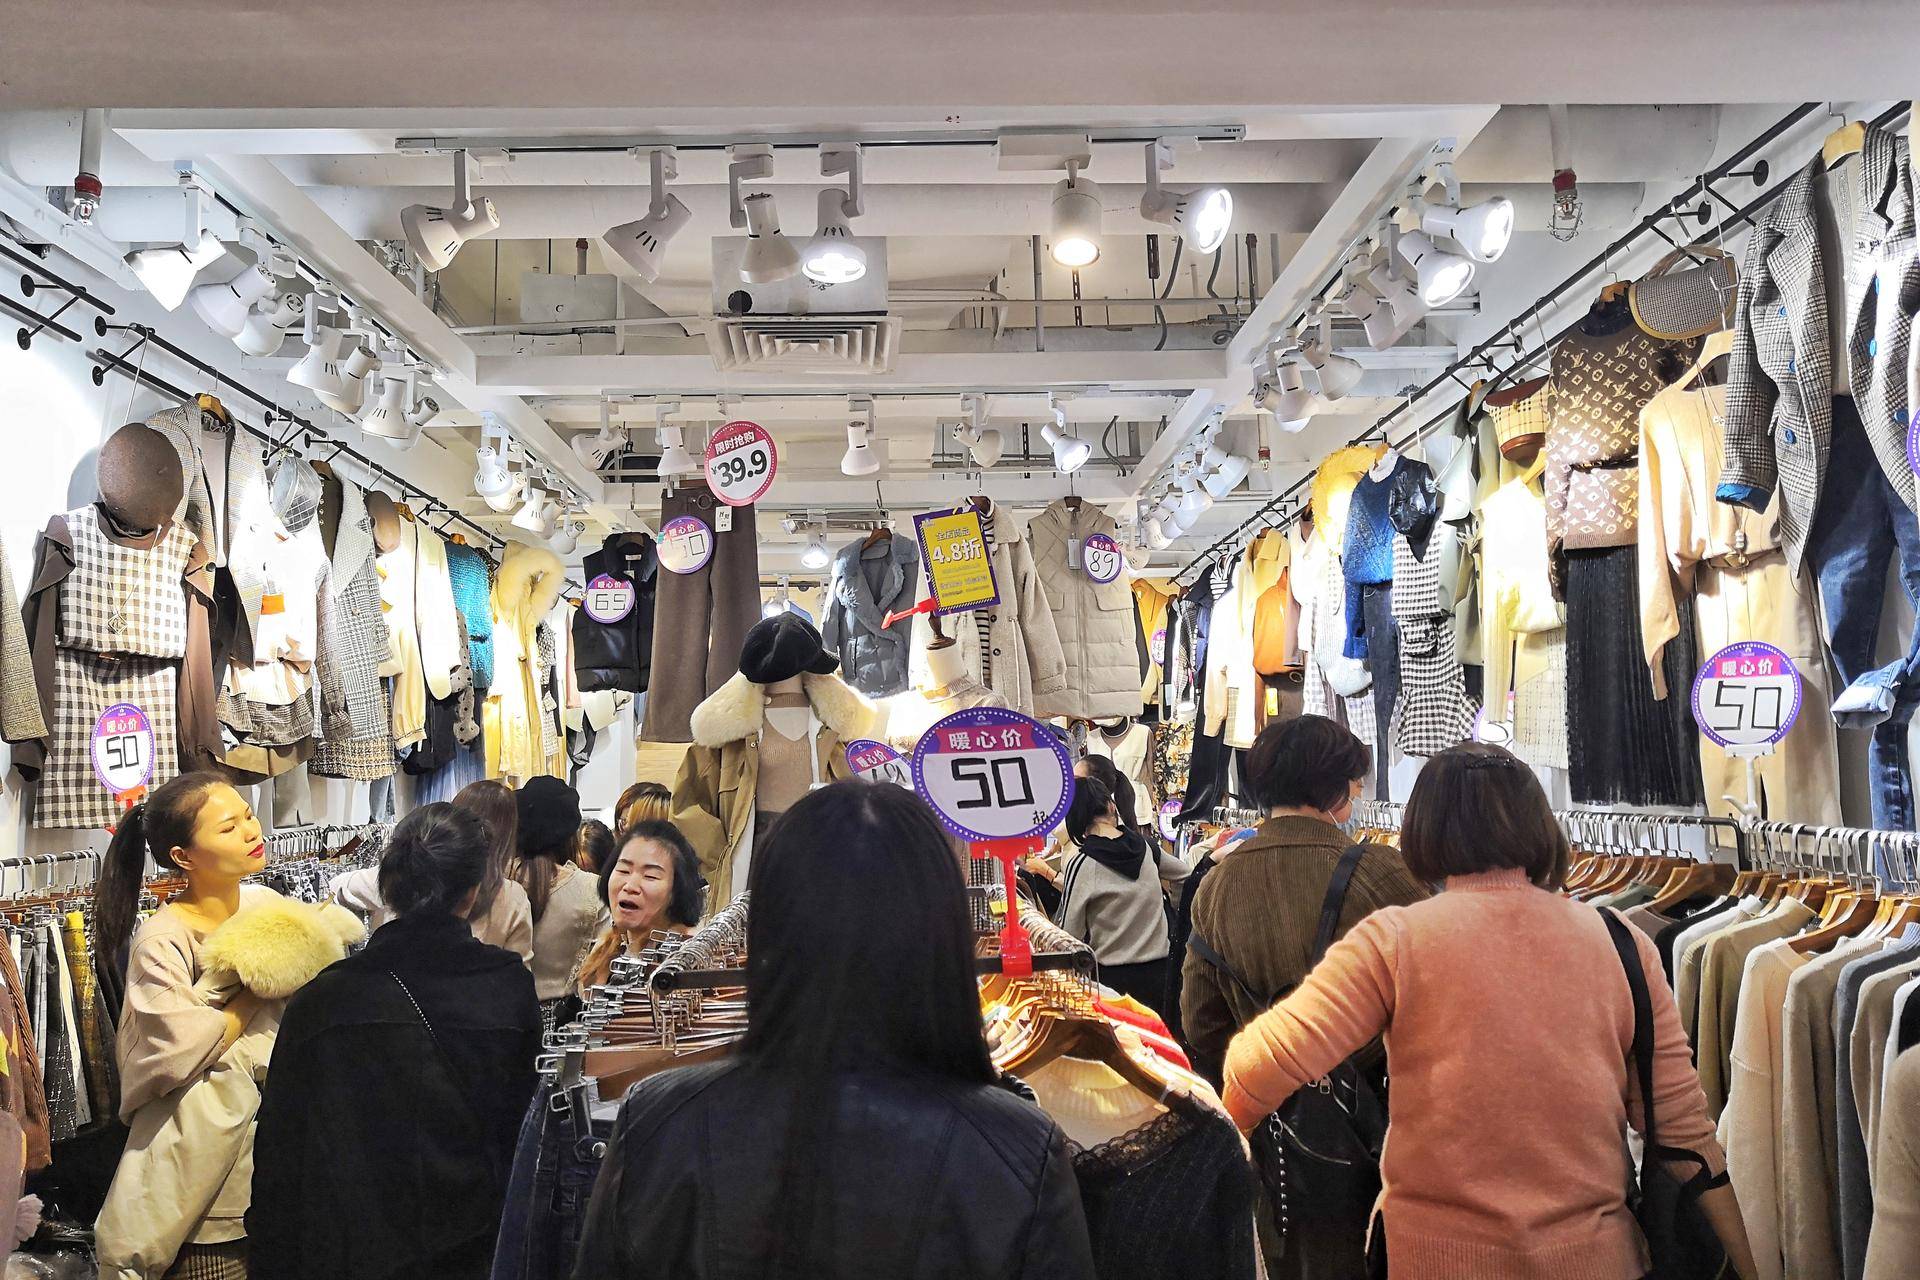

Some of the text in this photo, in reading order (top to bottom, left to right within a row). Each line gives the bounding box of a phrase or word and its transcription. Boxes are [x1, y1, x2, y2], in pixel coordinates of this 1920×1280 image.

[714, 431, 755, 455] 限时抢购
[932, 537, 982, 563] 4.8折
[1089, 551, 1115, 579] 89
[595, 593, 627, 611] 69
[1721, 658, 1773, 676] 暖心价
[1713, 680, 1782, 731] 50
[948, 728, 1023, 751] 暖心价
[106, 735, 139, 771] 50
[951, 757, 1035, 809] 50
